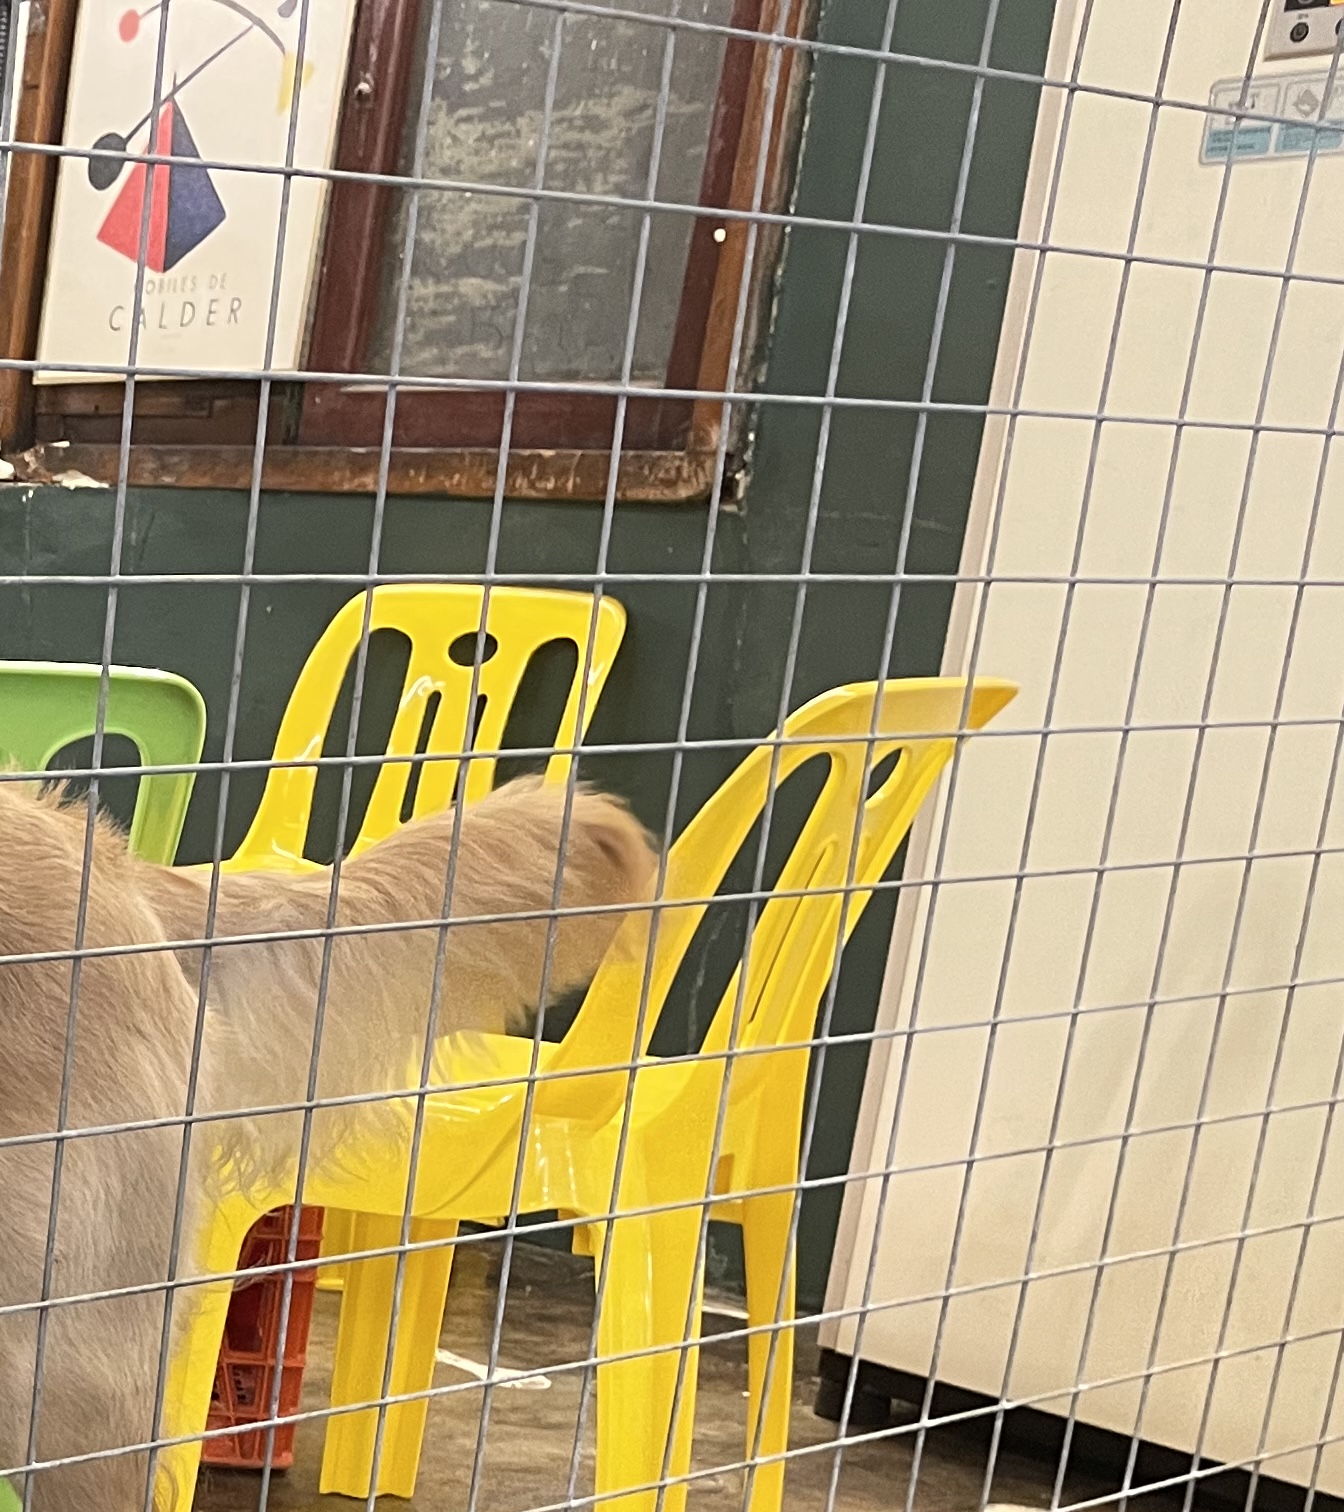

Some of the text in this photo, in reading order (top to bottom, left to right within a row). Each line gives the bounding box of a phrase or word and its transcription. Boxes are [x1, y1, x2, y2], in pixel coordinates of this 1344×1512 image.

[137, 272, 228, 296] OBILES DE
[108, 296, 243, 332] CALDER
